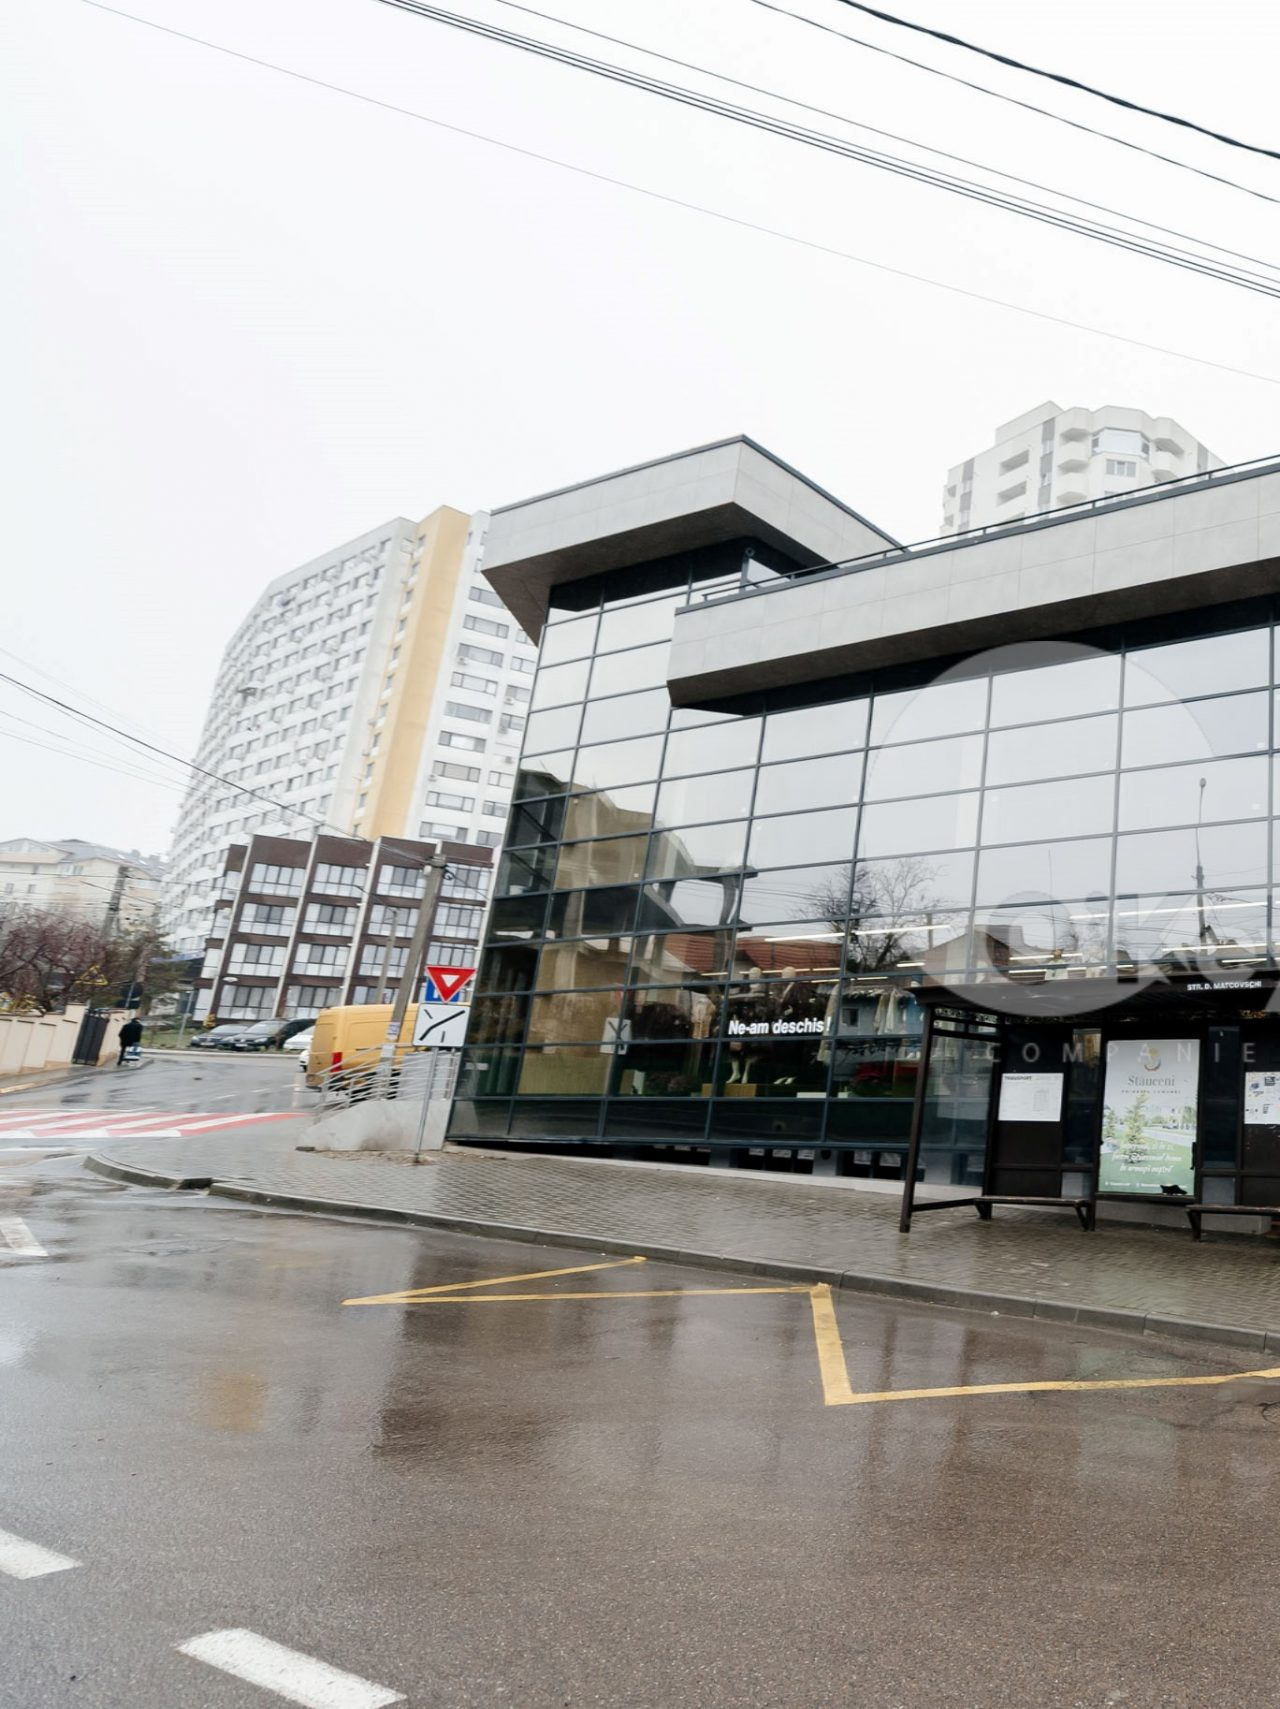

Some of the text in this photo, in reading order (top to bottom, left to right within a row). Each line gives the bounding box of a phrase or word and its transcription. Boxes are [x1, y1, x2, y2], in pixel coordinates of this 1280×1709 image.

[1187, 983, 1203, 991] STR.
[1213, 980, 1262, 990] MATCOVSCHI
[728, 1020, 769, 1035] Ne-am
